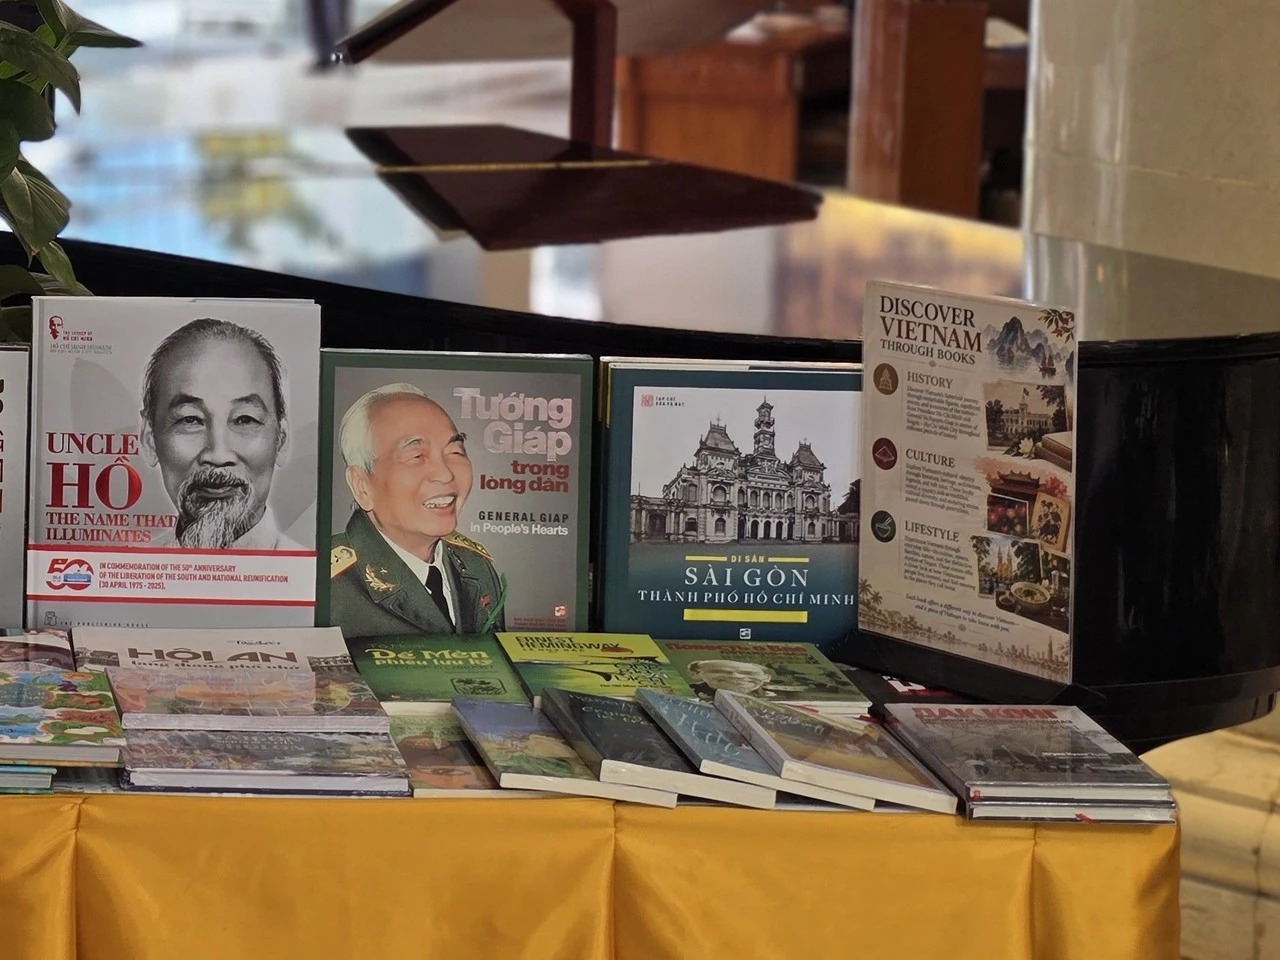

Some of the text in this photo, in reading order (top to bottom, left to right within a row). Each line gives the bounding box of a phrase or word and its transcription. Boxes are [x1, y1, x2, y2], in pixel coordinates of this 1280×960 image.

[880, 296, 975, 328] DISCOVER
[880, 315, 982, 352] VIETNAM
[880, 338, 976, 365] THROUGH BOOKS
[907, 371, 954, 389] HISTORY
[453, 387, 572, 428] Tướng
[46, 432, 138, 456] UNCLE
[483, 422, 572, 461] Giáp
[906, 448, 956, 468] CULTURE
[511, 460, 570, 480] trong
[46, 456, 142, 510] HỒ
[480, 474, 569, 494] lòng dân
[46, 512, 178, 528] THE NAME THAT
[478, 510, 569, 523] GENERAL GIAP
[46, 528, 152, 543] ILLUMINATES
[471, 523, 568, 536] in People's Hearts
[905, 520, 960, 542] LIFESTYLE
[46, 558, 94, 590] 50
[106, 562, 160, 570] COMMEMORATION
[685, 564, 809, 588] SÀI GÒN
[638, 589, 698, 603] THÀNH
[773, 592, 804, 605] CHÍ
[810, 594, 854, 606] MINH
[128, 647, 298, 663] HỘI AN
[520, 642, 621, 650] HEMINGWAY
